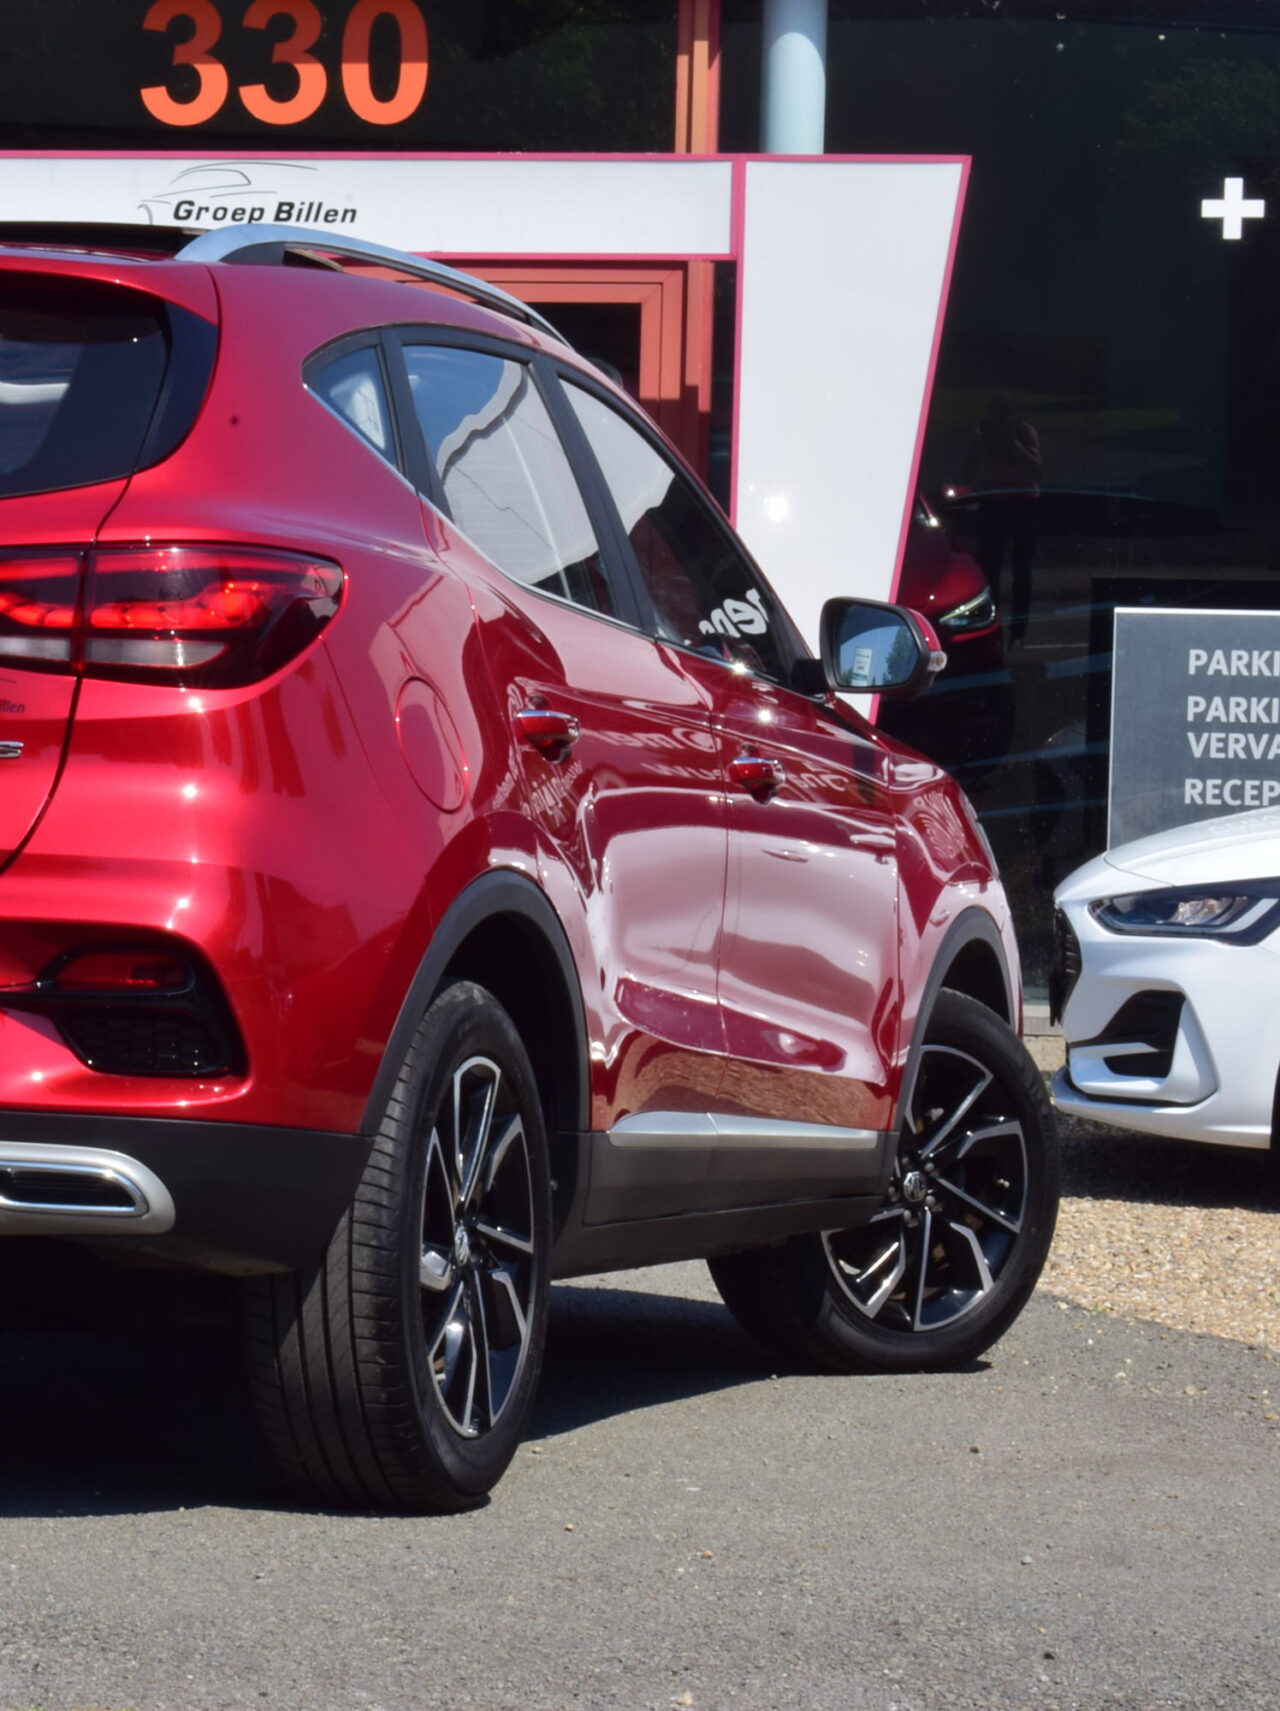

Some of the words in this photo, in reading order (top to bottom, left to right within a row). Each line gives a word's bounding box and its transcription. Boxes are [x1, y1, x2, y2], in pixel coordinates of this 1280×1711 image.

[140, 0, 429, 127] 330
[173, 200, 265, 224] Groep
[273, 201, 357, 224] Billen
[1188, 649, 1280, 677] PARKI
[1186, 695, 1280, 723] PARKI
[1184, 778, 1280, 806] RECEP
